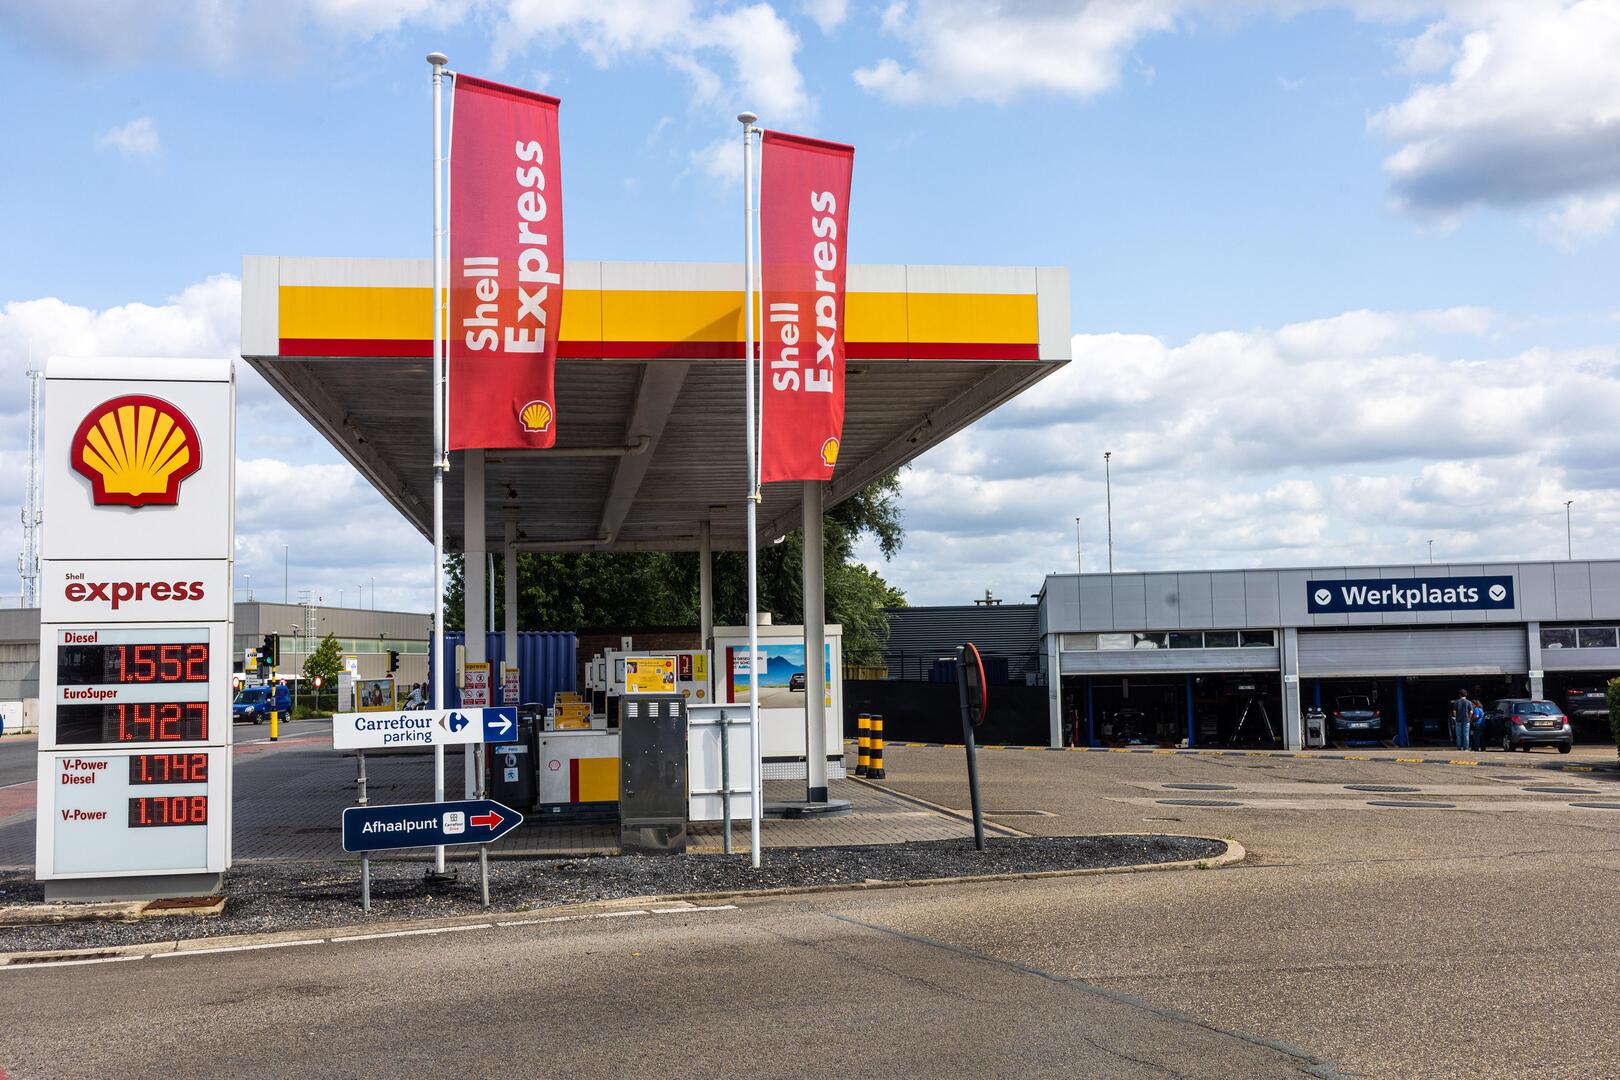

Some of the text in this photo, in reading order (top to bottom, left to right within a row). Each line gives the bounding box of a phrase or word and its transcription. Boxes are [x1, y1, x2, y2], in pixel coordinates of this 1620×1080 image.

[504, 140, 561, 353] Express
[463, 256, 499, 352] Shell
[804, 190, 837, 394] Express
[769, 302, 800, 392] Shell
[65, 580, 205, 610] express
[1341, 583, 1479, 609] Werkplaats
[64, 631, 98, 643] Diesel
[118, 645, 208, 682] 1.552
[63, 687, 118, 701] EuroSuper
[118, 703, 208, 740] 1.427
[354, 715, 433, 731] Carrefour
[383, 730, 433, 744] parking
[62, 759, 108, 771] V-Power
[139, 754, 207, 781] 1.742
[61, 772, 96, 785] Diesel
[61, 809, 107, 821] V-Power
[139, 796, 207, 824] 1.708
[362, 817, 438, 834] Afhaalpunt
